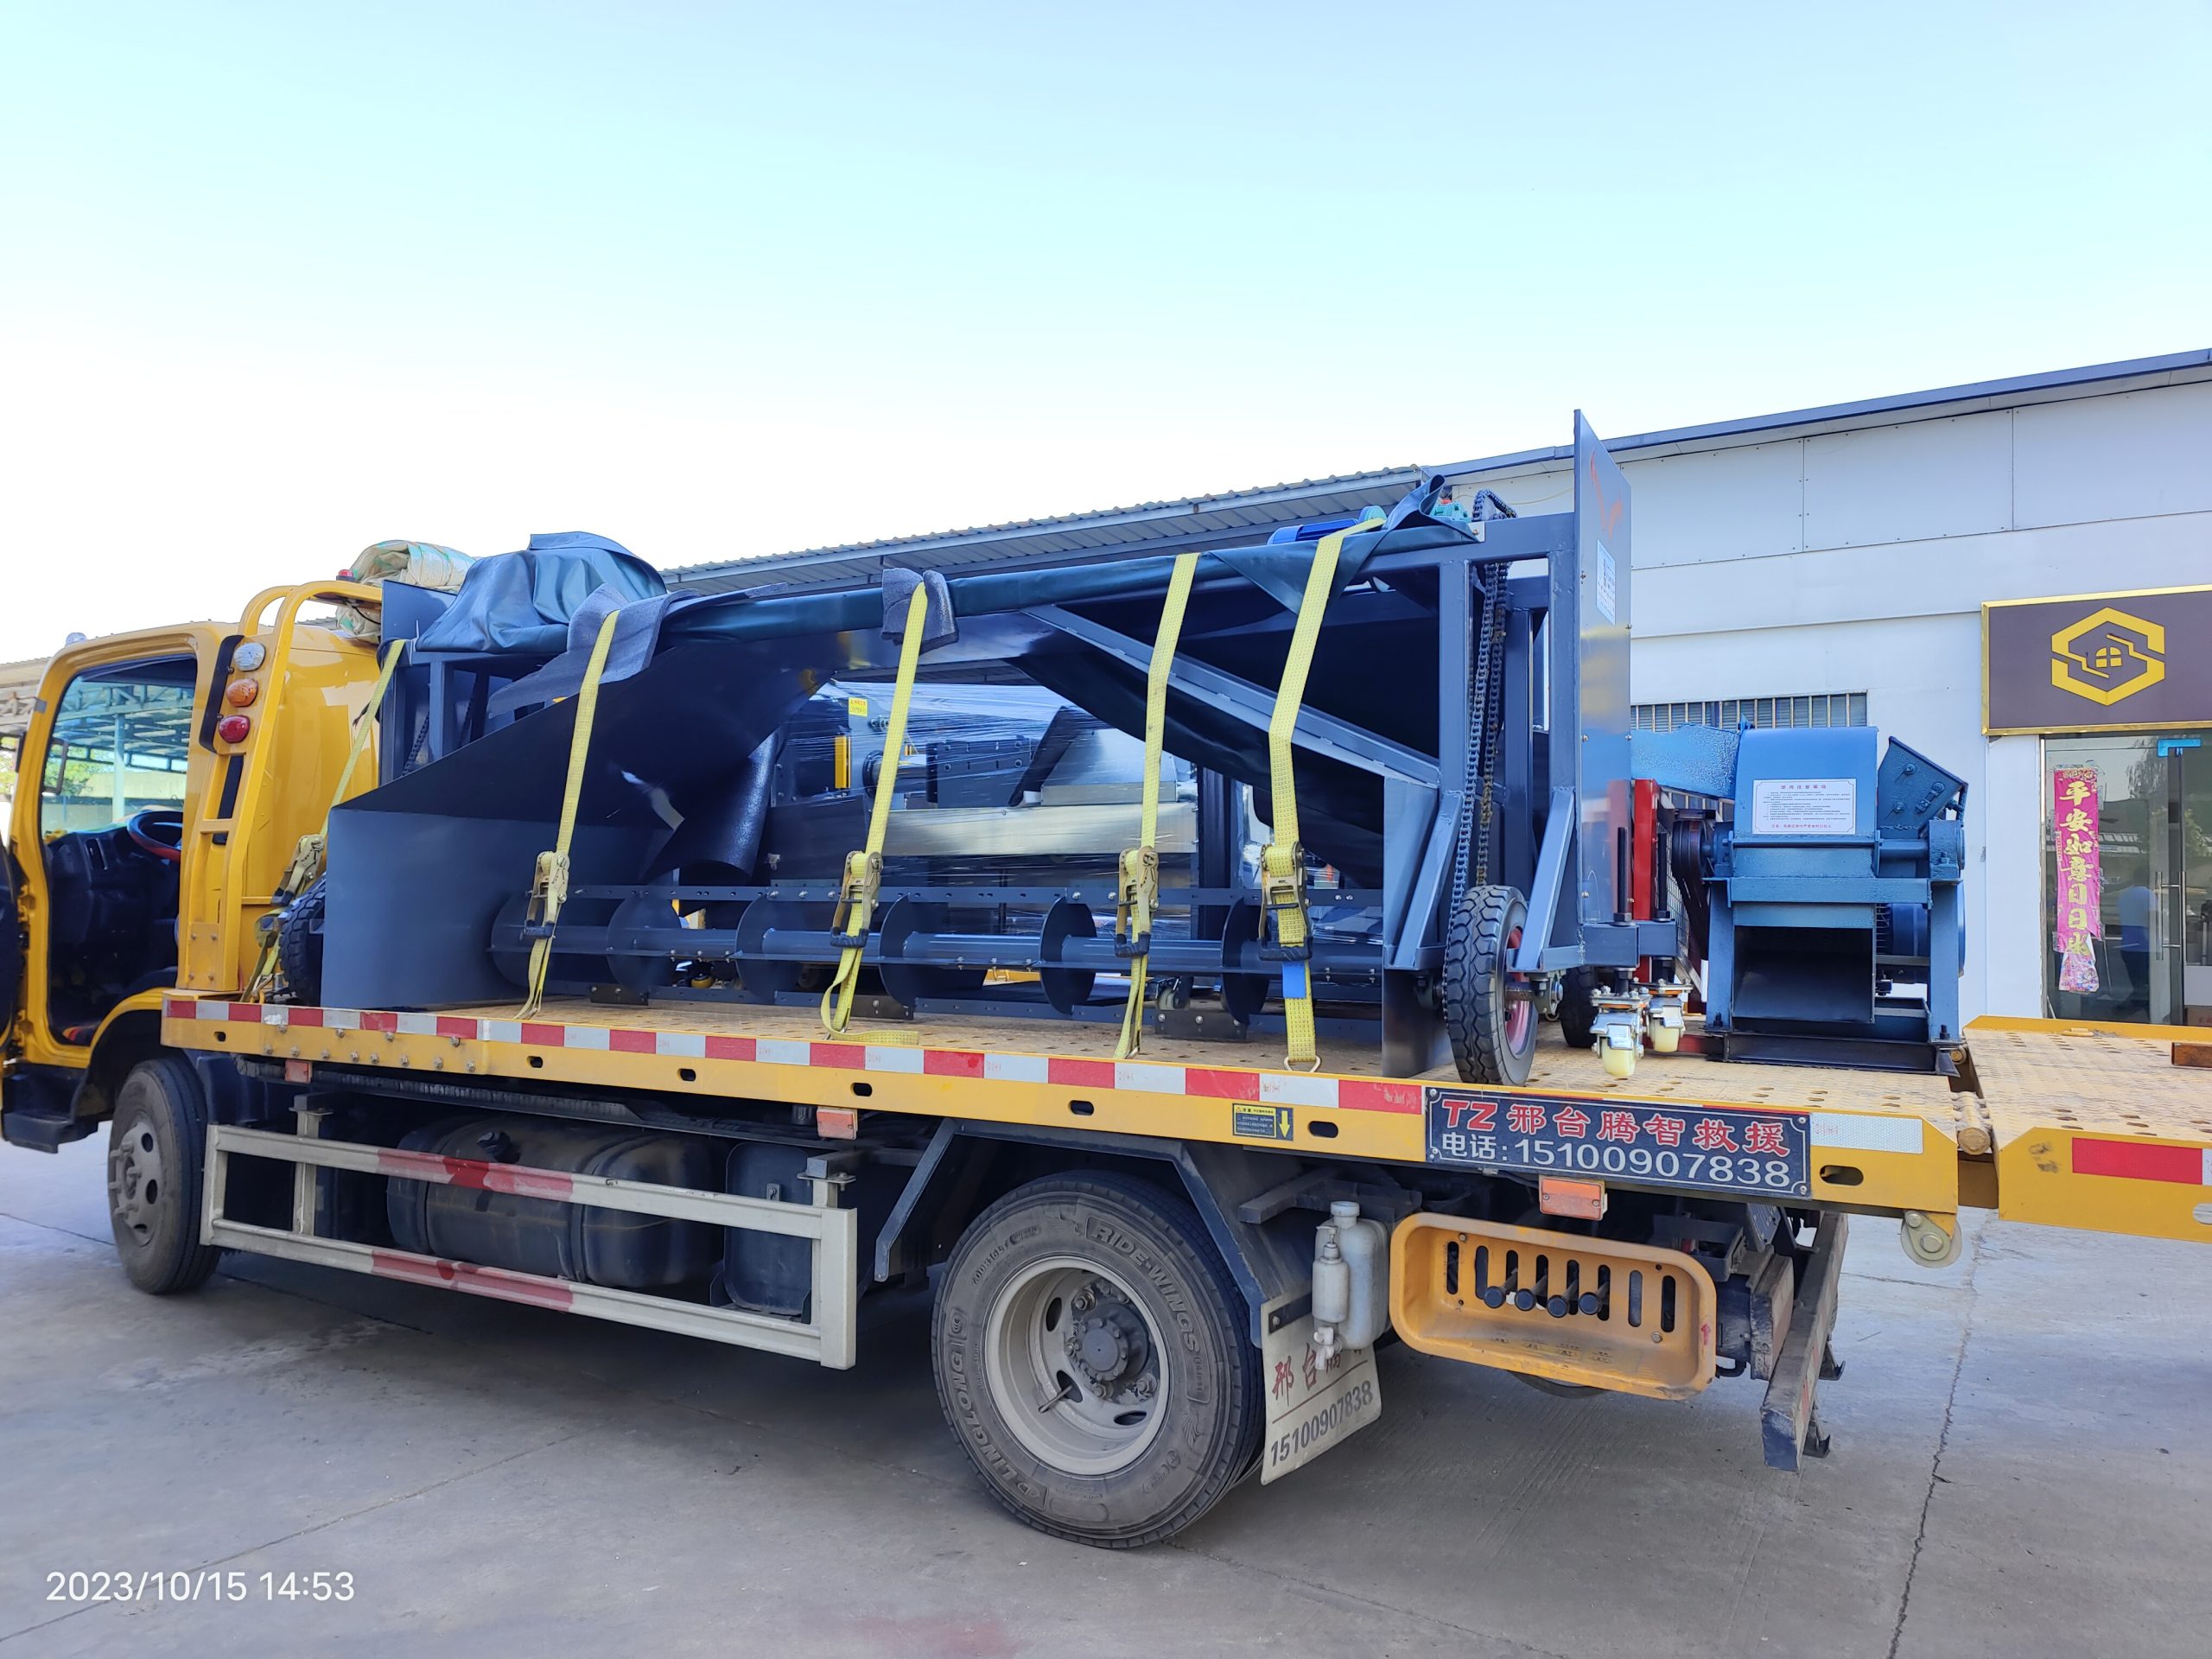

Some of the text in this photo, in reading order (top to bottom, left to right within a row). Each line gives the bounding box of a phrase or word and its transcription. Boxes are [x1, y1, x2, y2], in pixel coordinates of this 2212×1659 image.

[1441, 1100, 1792, 1157] TZ 邢台腾智救援
[1092, 1223, 1200, 1354] RIDE-WINGS
[950, 1351, 1018, 1481] LINGLONG
[1270, 1380, 1373, 1467] 15100907838
